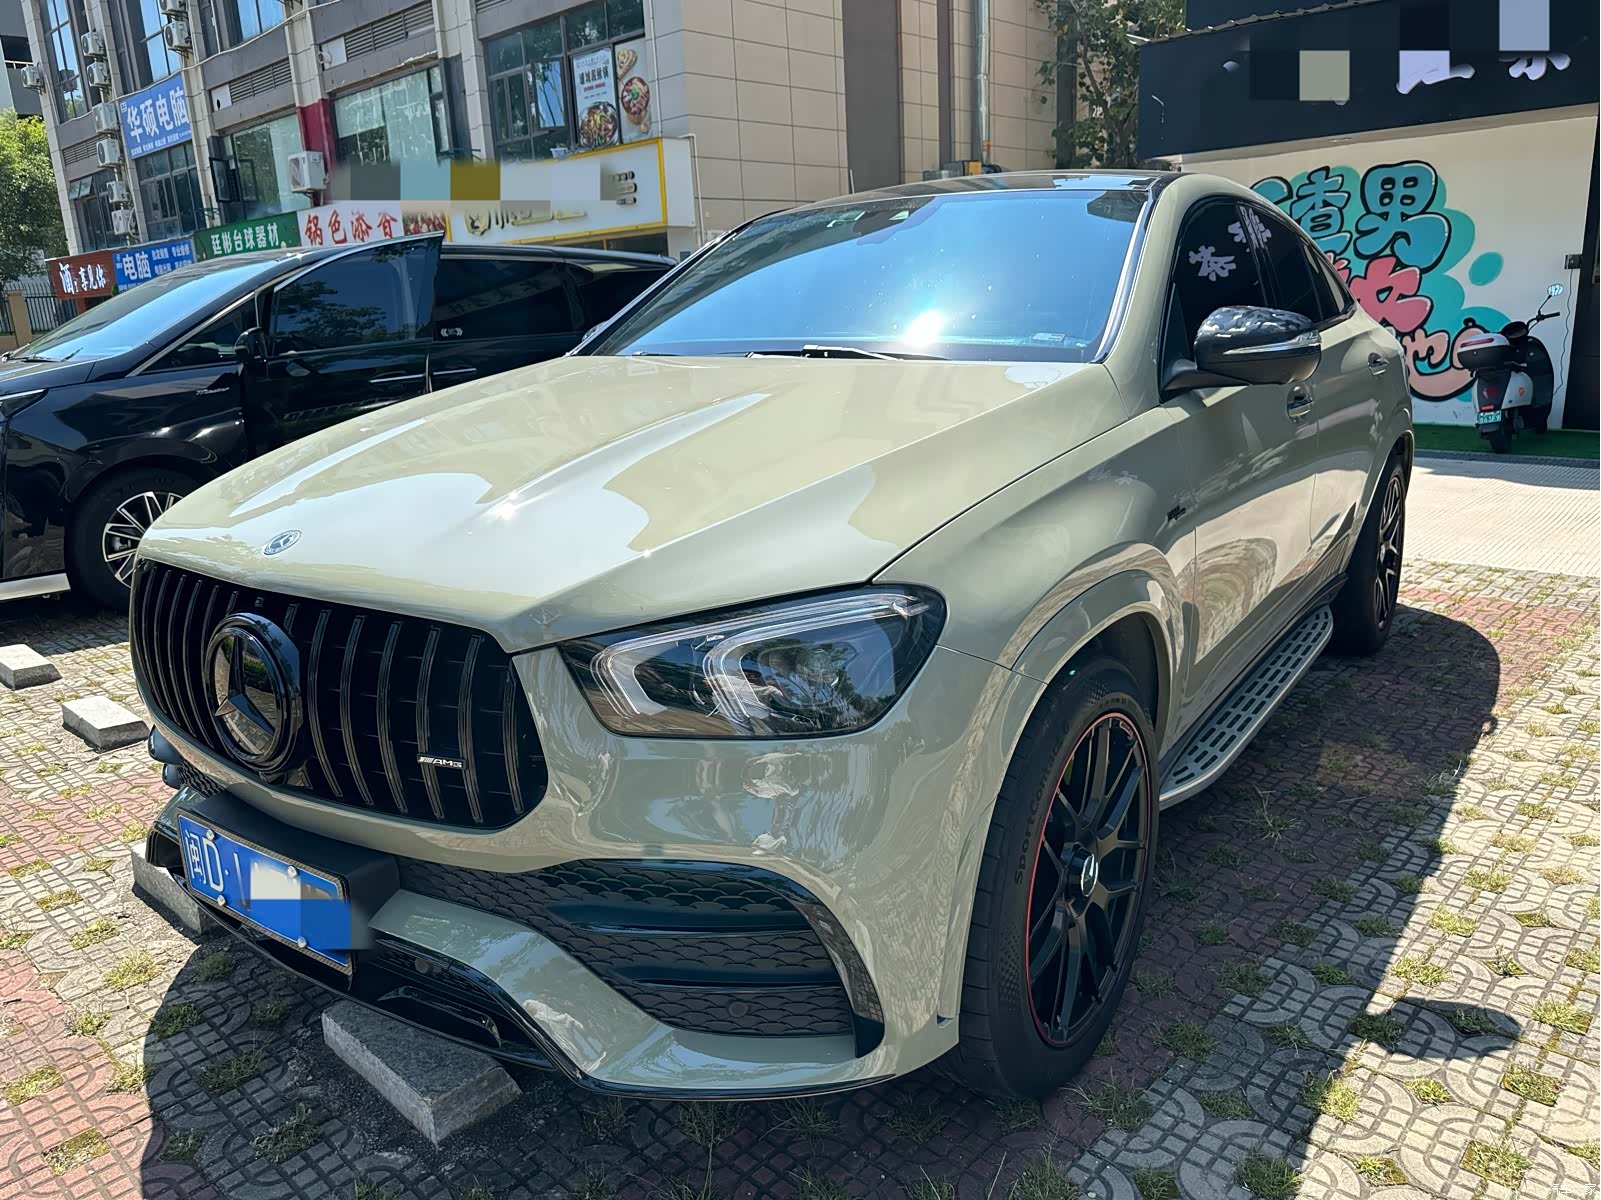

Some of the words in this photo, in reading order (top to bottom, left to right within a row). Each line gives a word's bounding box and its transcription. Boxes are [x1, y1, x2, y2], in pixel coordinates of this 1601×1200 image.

[127, 86, 190, 143] 华硕电脑
[122, 251, 152, 280] 电脑
[432, 758, 463, 769] AMG
